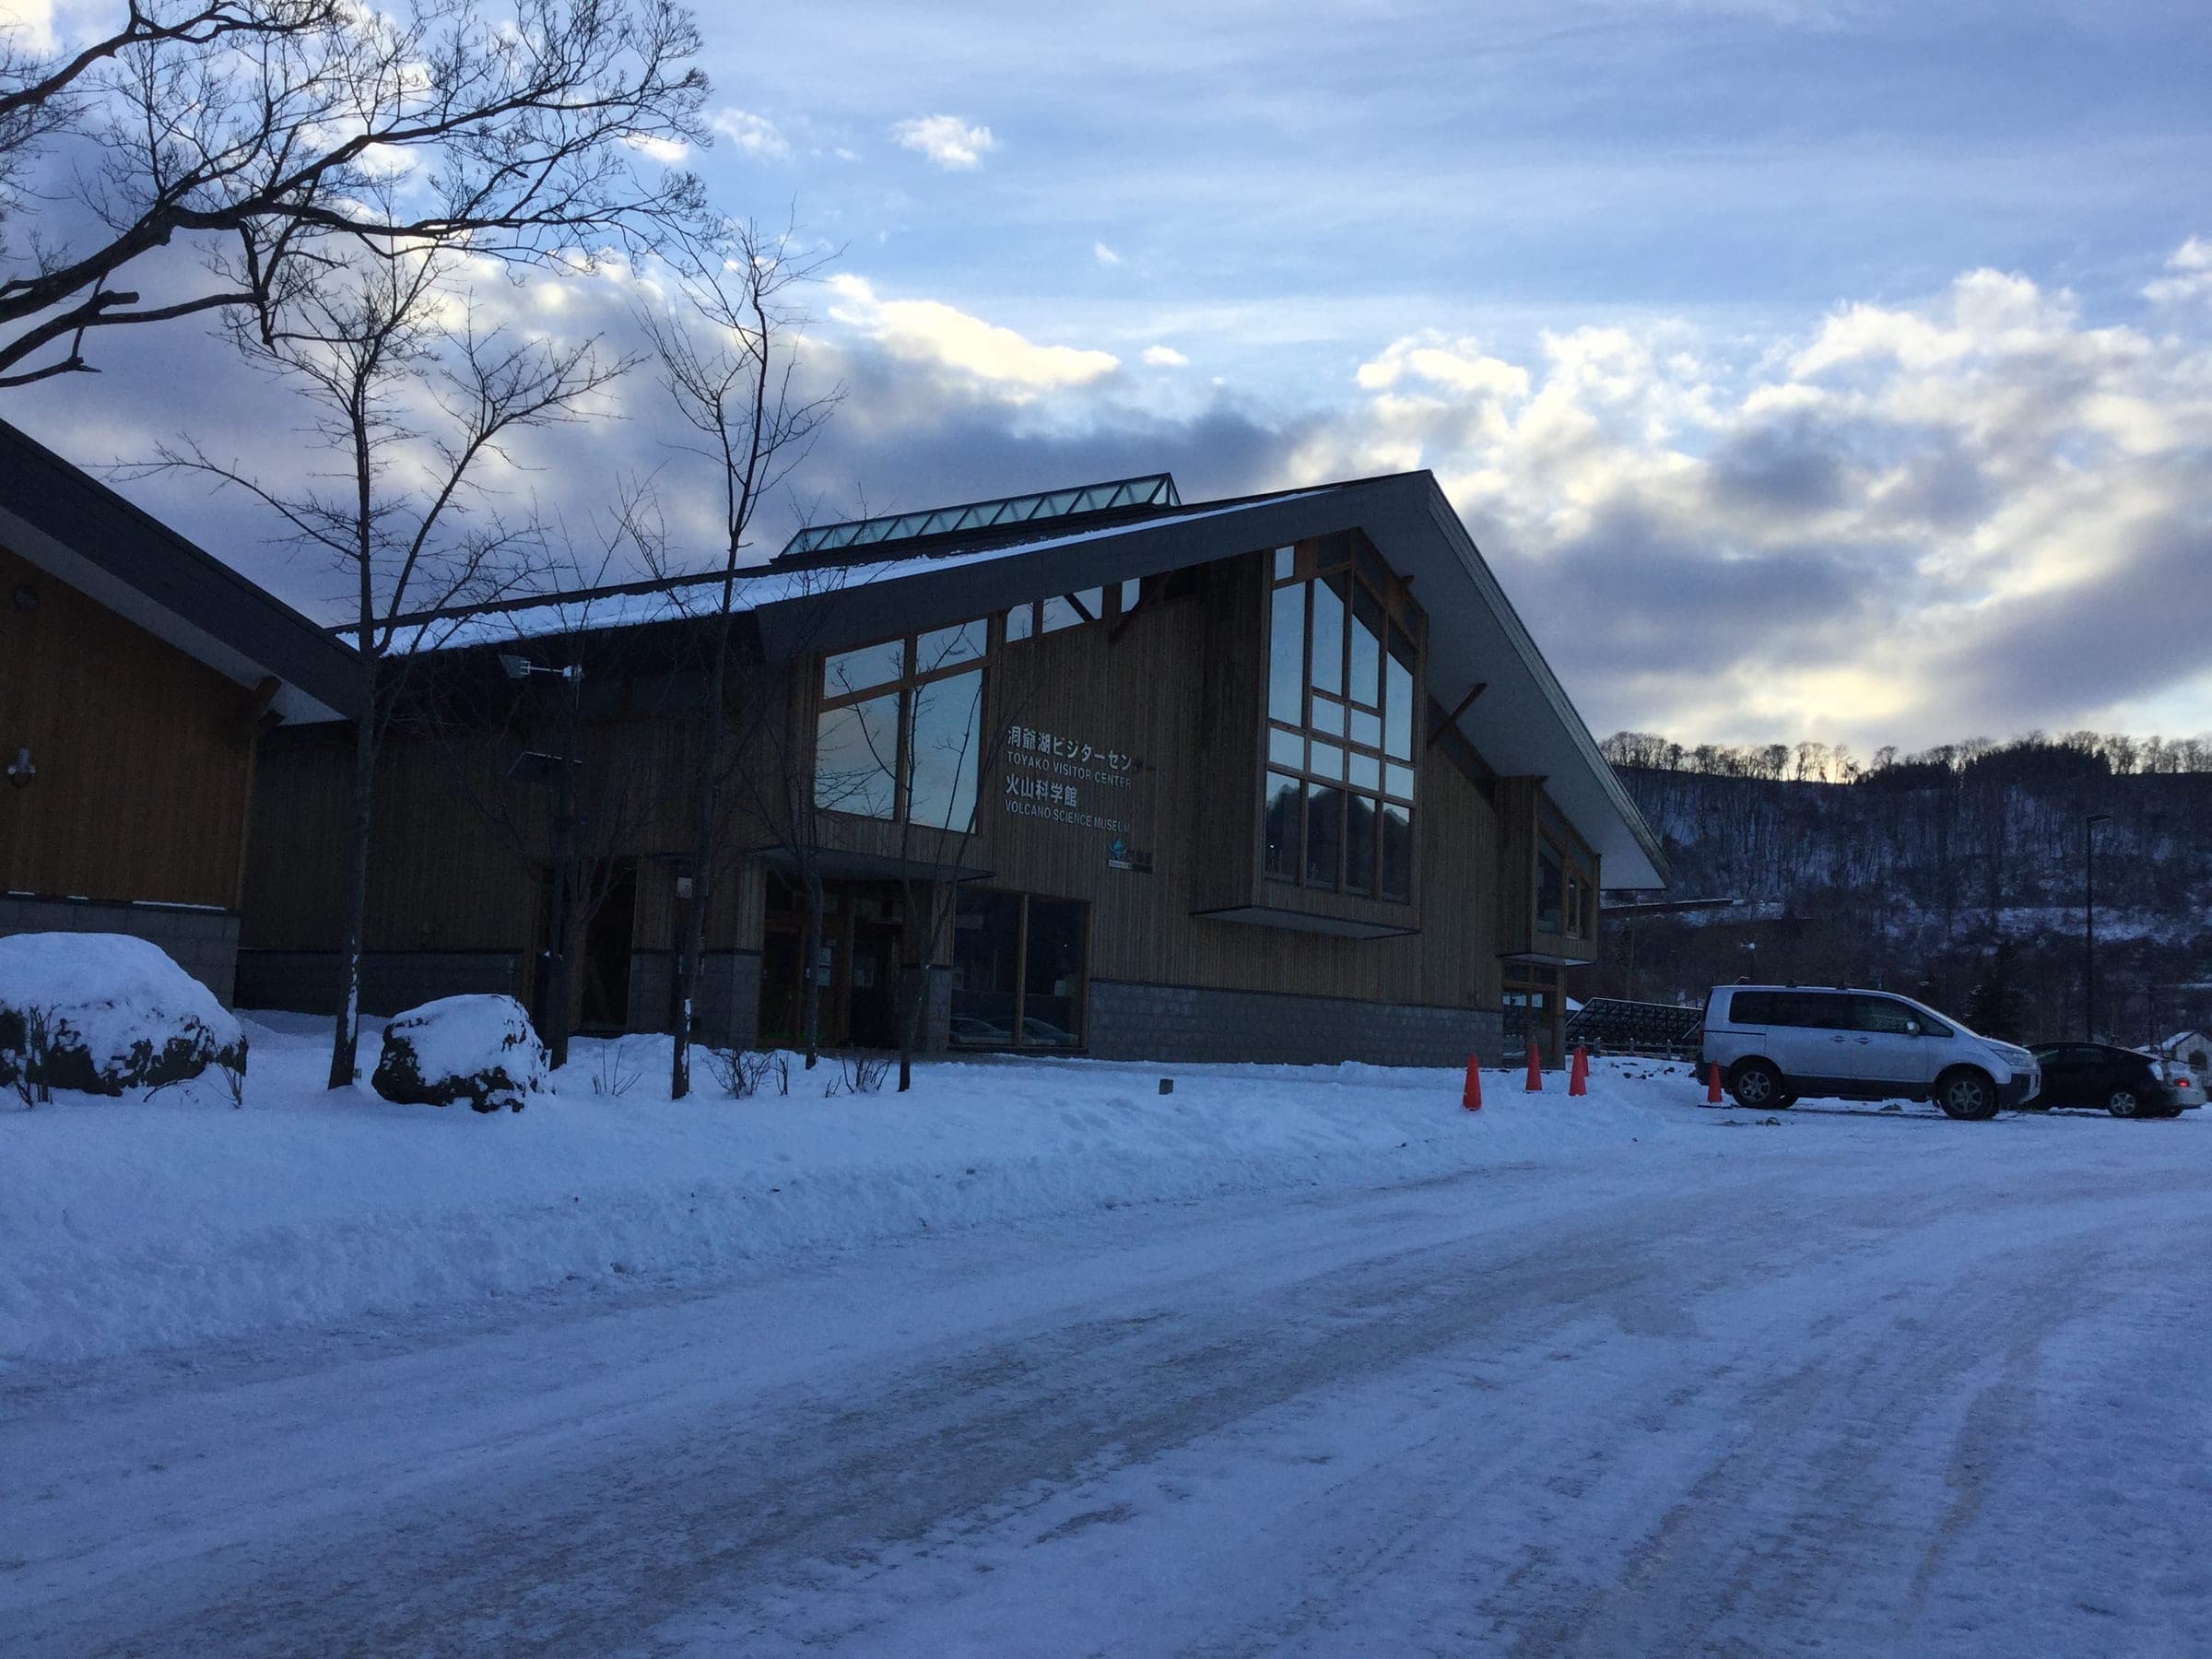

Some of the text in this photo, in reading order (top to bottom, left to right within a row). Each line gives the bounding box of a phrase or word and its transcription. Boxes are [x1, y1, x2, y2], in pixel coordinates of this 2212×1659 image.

[1006, 751, 1132, 789] TOYAKO VISITOR CENTER
[1005, 773, 1077, 807] 火山科学館
[1005, 799, 1131, 833] VOLCANO SCIENCE MUSEUM
